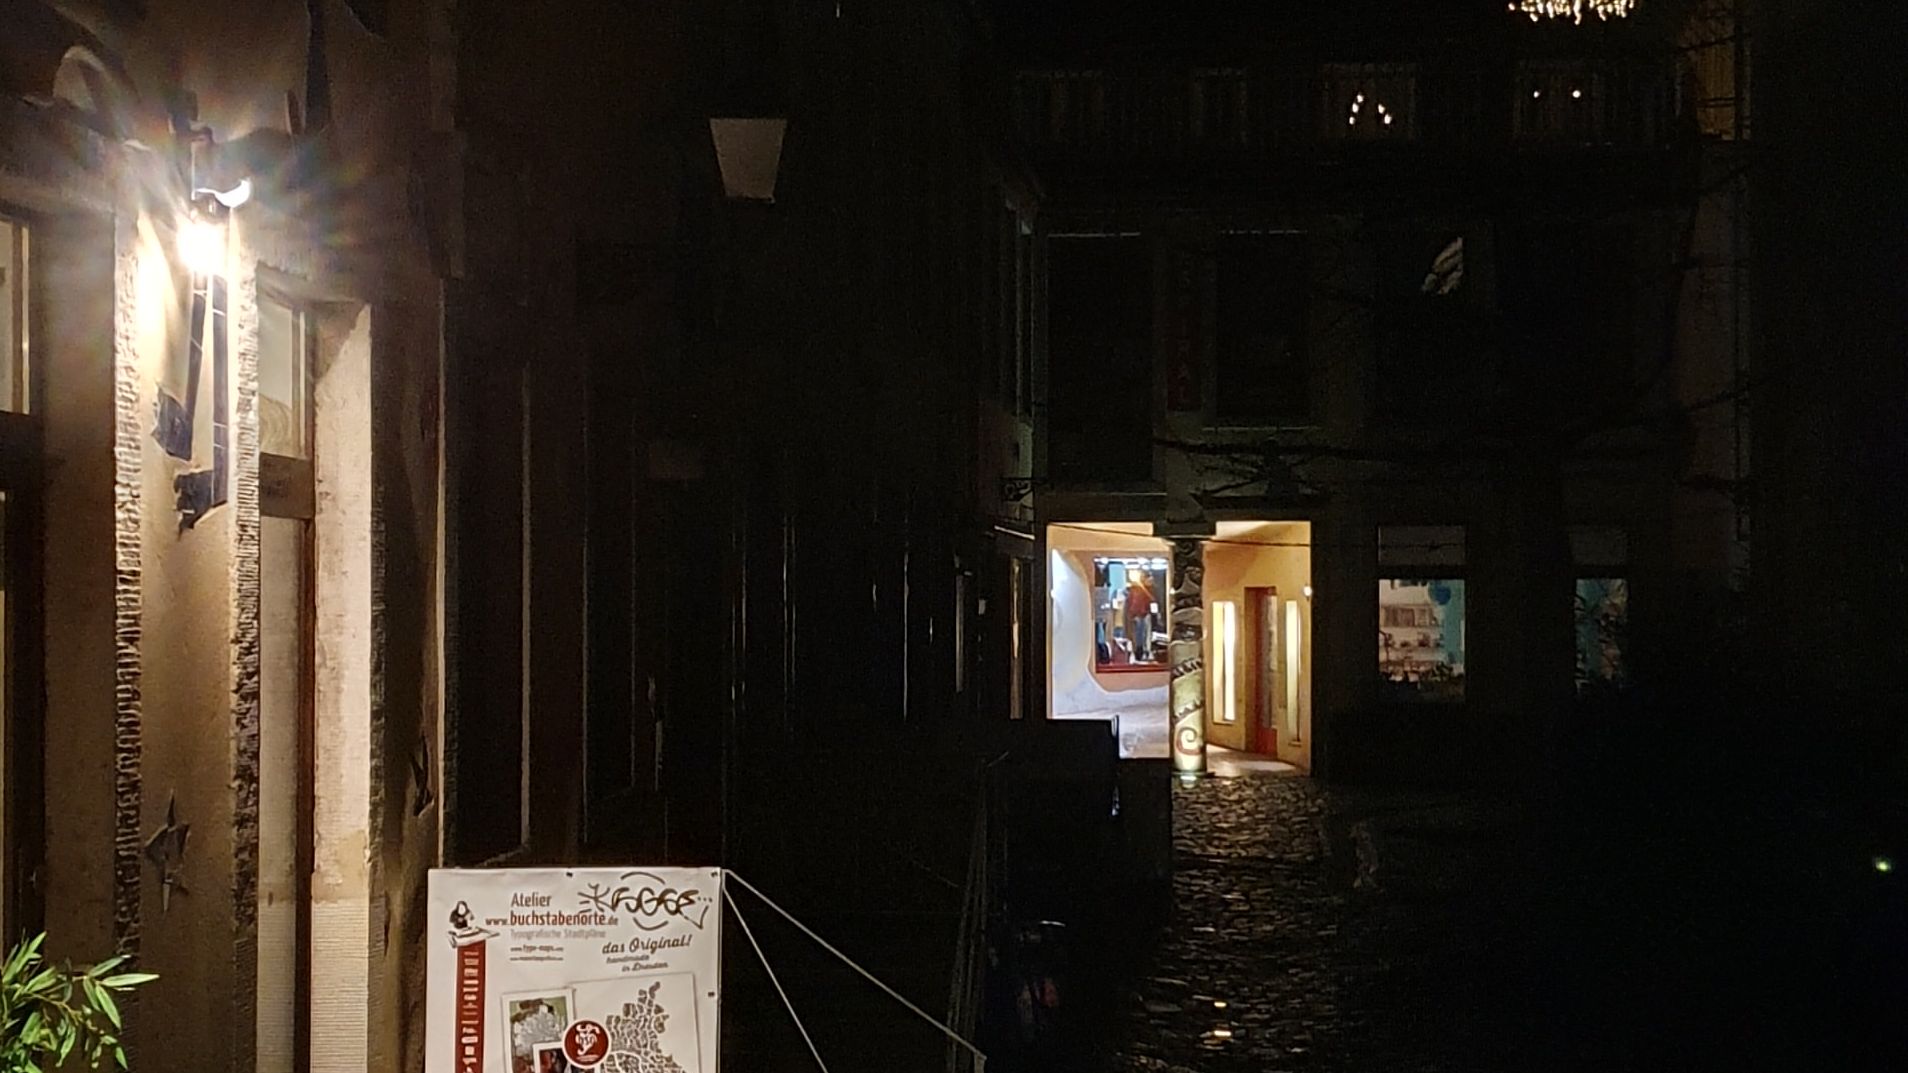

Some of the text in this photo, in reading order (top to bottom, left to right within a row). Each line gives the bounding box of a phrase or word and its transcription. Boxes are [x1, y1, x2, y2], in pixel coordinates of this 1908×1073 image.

[511, 892, 552, 908] Atelier
[602, 933, 693, 955] das Original!
